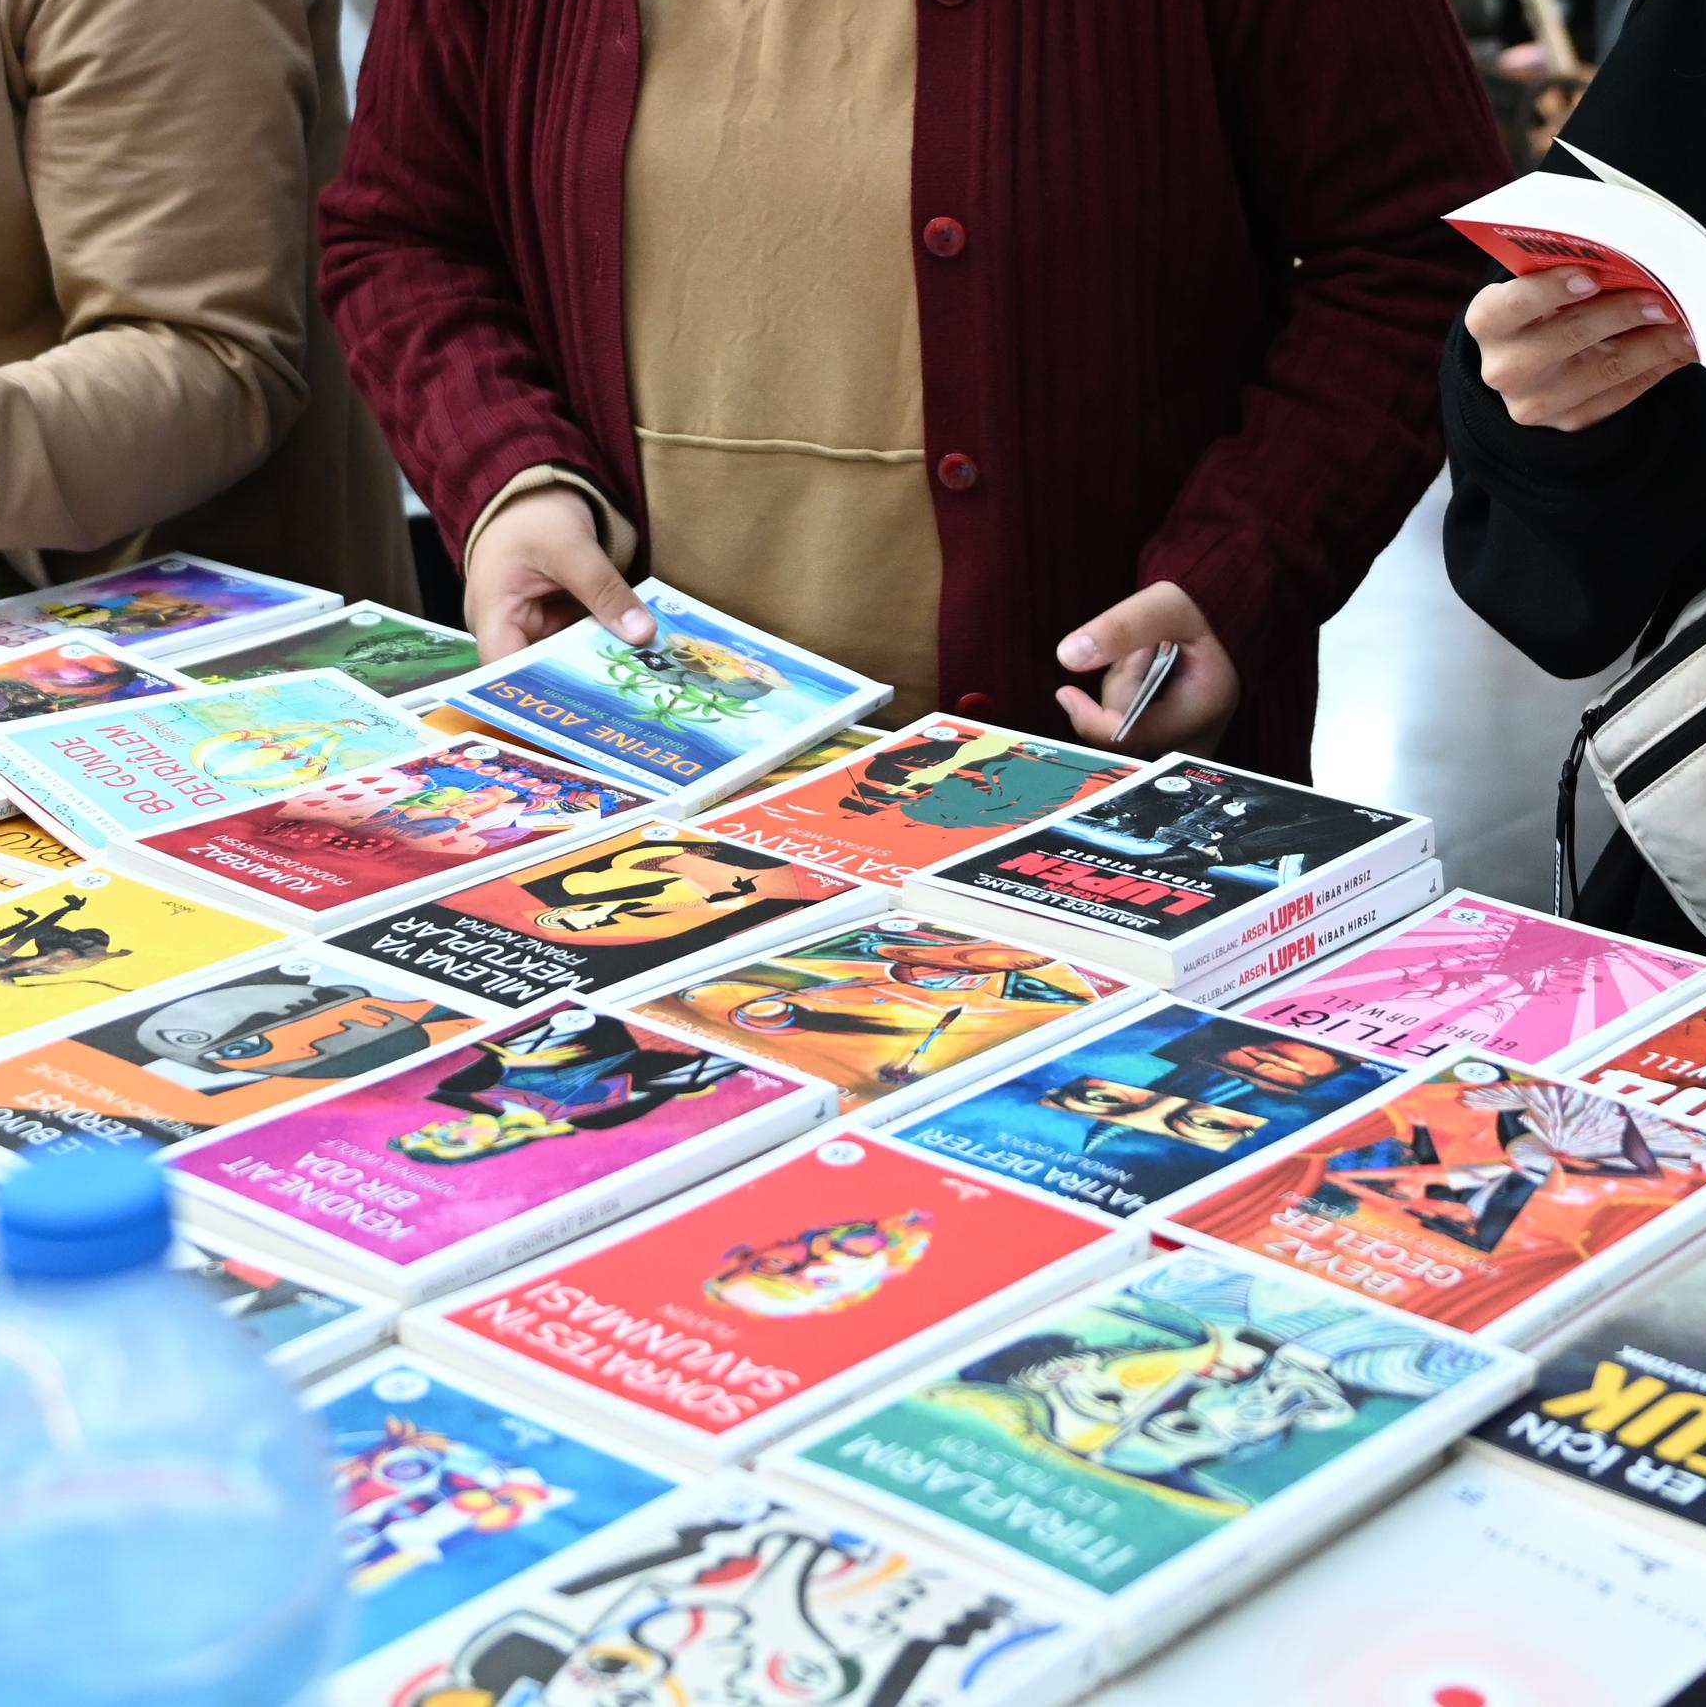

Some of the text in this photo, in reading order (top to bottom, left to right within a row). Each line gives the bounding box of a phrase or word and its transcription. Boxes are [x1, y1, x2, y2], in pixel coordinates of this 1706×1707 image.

[484, 678, 703, 777] DEFİNE ADASI
[542, 687, 689, 752] Robert Louis Stevenson
[50, 735, 175, 816] 80 GÜNDE
[1183, 768, 1225, 783] NETFLIX
[187, 841, 324, 895] KUMARBAZ
[212, 833, 352, 887] FYODOR DOSTOYEVSKİ
[706, 819, 919, 884] SATRANÇ
[785, 826, 893, 857] STEFAN ZWEIG
[972, 875, 1150, 931] MAURICE LEBLANC
[995, 850, 1215, 917] LUPEN
[387, 913, 594, 993] MEKTUPLAR
[452, 915, 588, 967] FRANZ KAFKA
[1182, 868, 1372, 974] MAURICE LEBLANC ARSEN LUPEN KİBAR HIRSIZ
[1238, 961, 1268, 987] ARSEN
[1266, 932, 1316, 977] LUPEN
[1316, 923, 1348, 948] KİBAR
[1346, 909, 1378, 935] HIRSIZ
[1323, 993, 1519, 1054] GEORGE ORWELL
[14, 1087, 140, 1147] ZERDÜŞT
[293, 1149, 421, 1211] BİR ODA
[913, 1126, 1046, 1179] DEFTERİ
[218, 1153, 416, 1243] KENDİNE AİT
[1041, 1158, 1148, 1212] HATIRA
[1263, 1233, 1404, 1296] BEYAZ
[1269, 1207, 1466, 1290] GECELER
[522, 1279, 802, 1400] SAVUNMASI
[655, 1301, 742, 1341] PLATON
[470, 1297, 759, 1427] SOKRATES'İN
[1505, 1409, 1626, 1479] İÇİN
